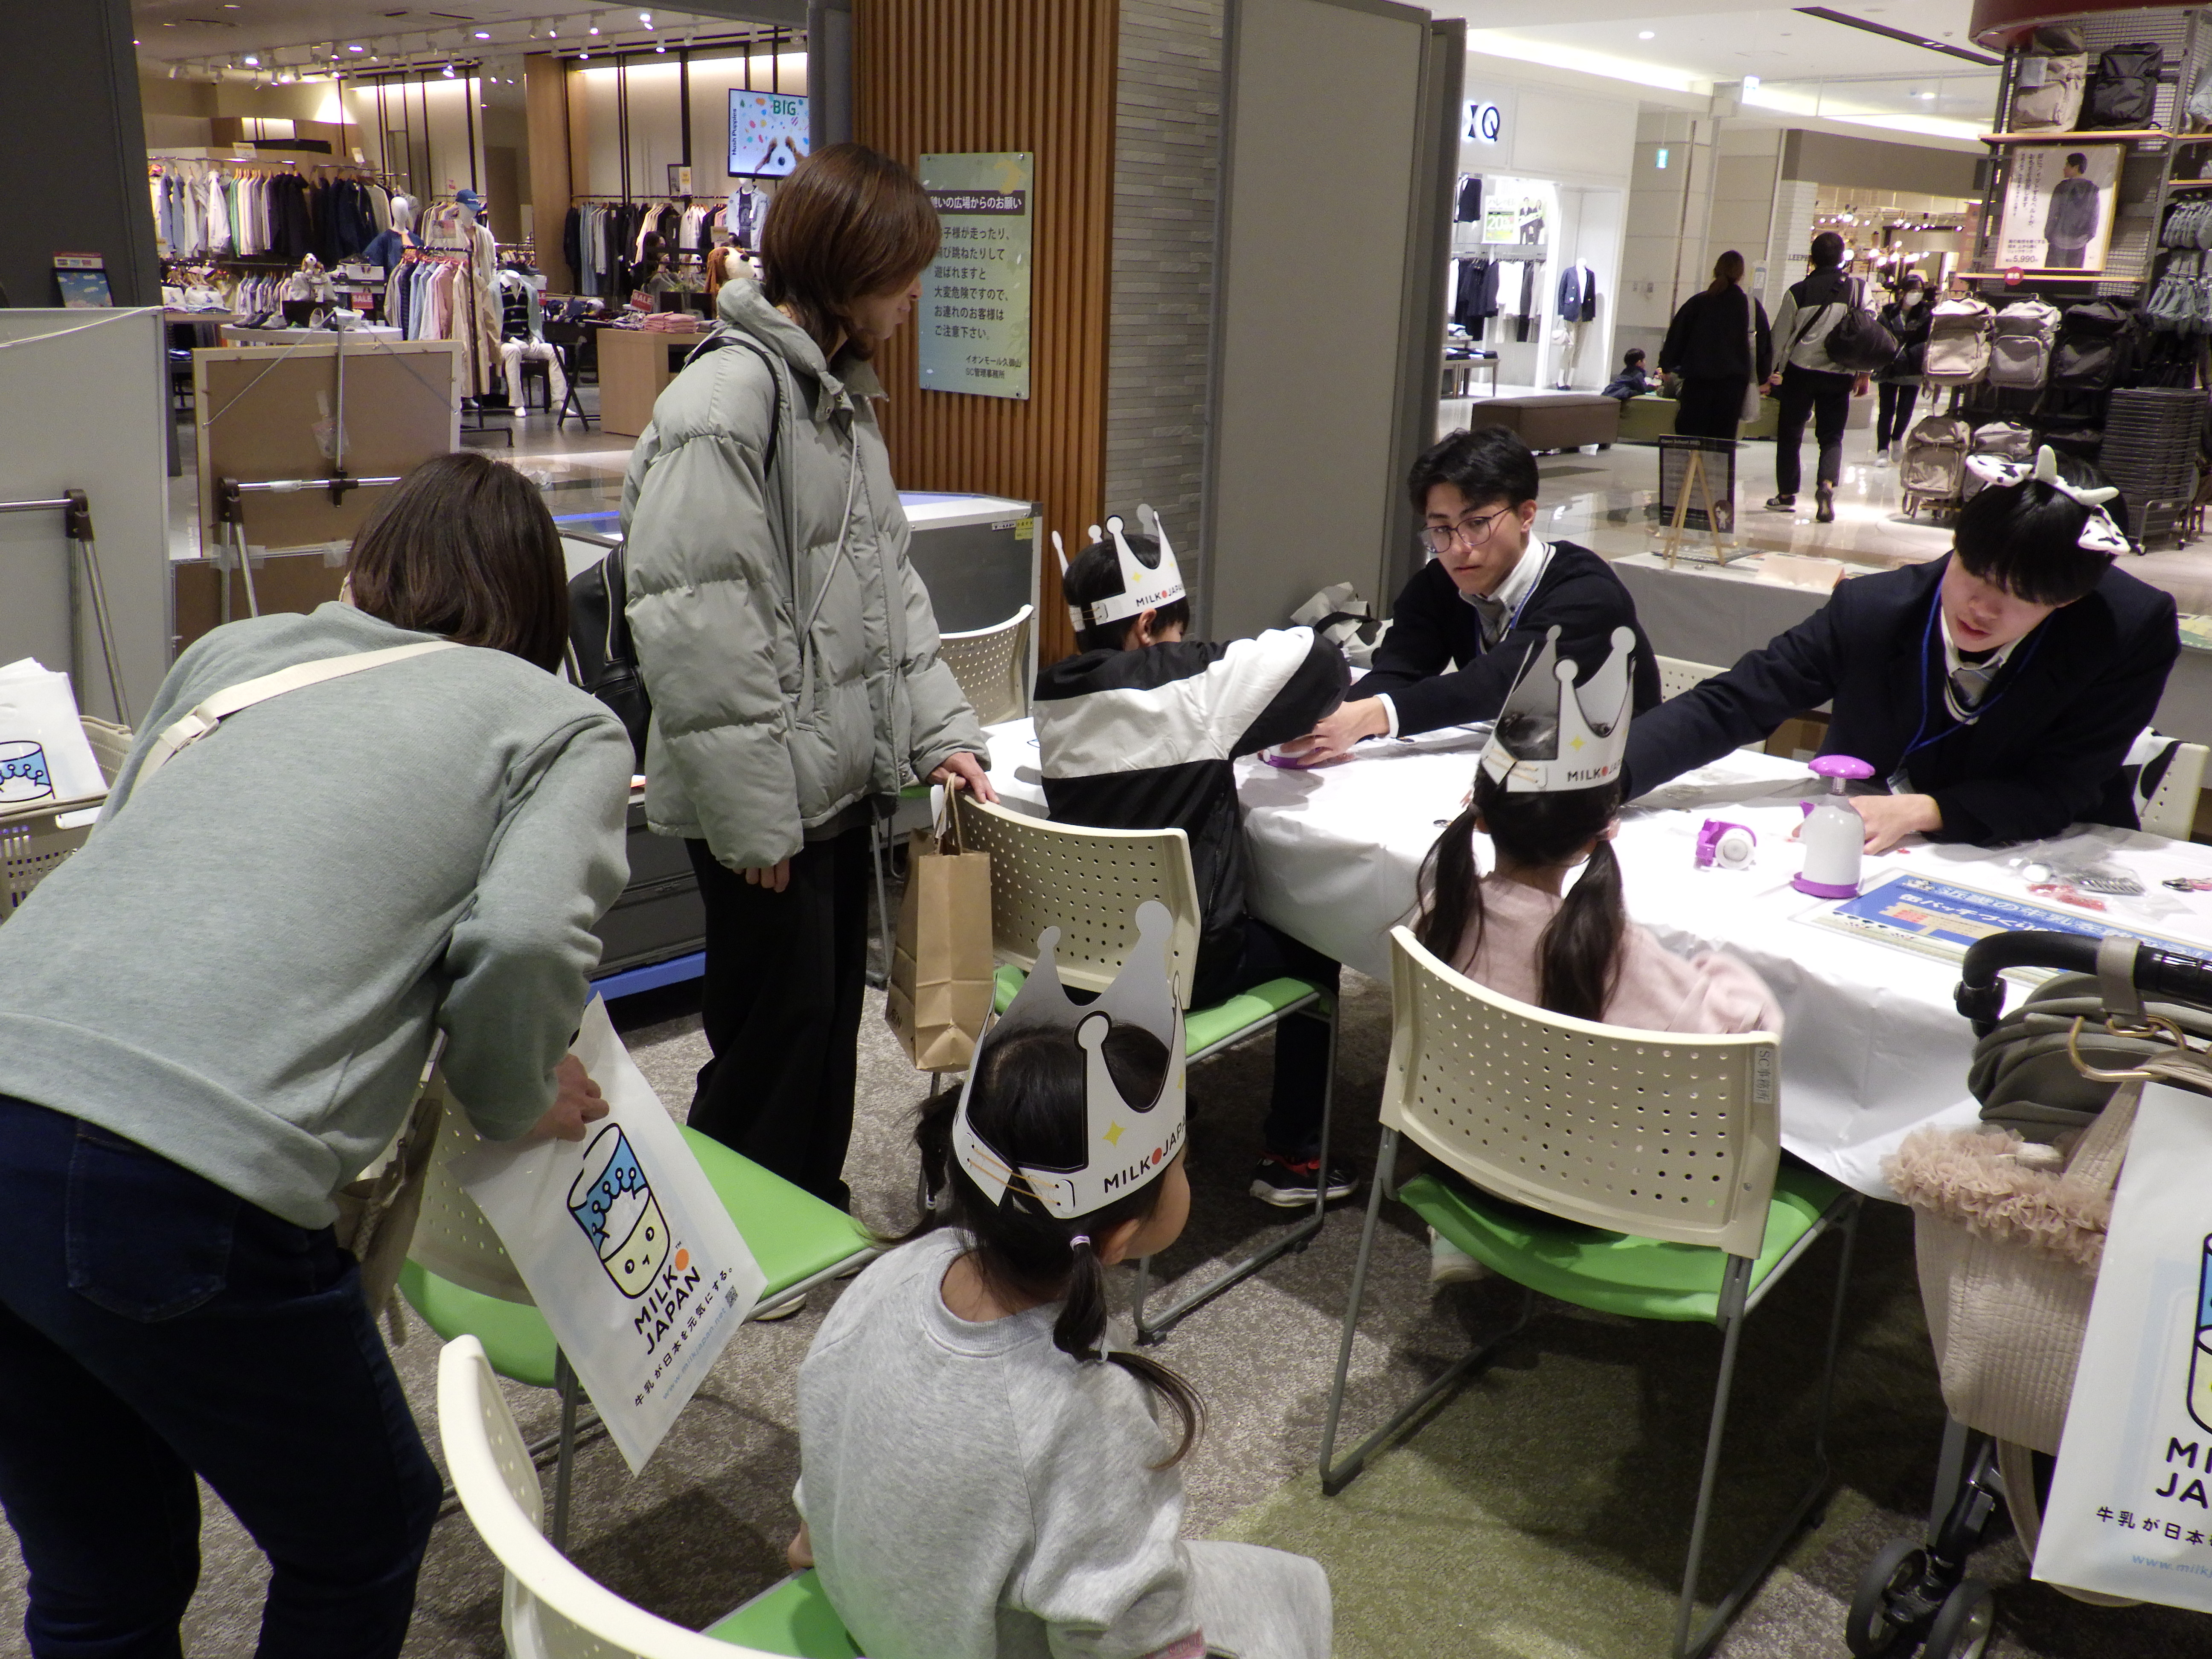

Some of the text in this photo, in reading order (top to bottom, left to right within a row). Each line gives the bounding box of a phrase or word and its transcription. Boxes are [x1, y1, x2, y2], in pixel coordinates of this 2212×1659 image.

[773, 99, 796, 116] BIG
[940, 226, 1009, 240] 子様が走ったり、
[934, 265, 986, 279] 遊ばれますと
[633, 292, 655, 305] SALE
[934, 285, 1008, 301] 大変危険ですので、
[934, 305, 1004, 320] お連れのお客様は
[935, 324, 990, 340] ご注意下さい。
[1136, 593, 1161, 608] MILK
[1567, 768, 1601, 783] MILK
[1103, 1155, 1151, 1194] MILK
[634, 1264, 678, 1335] MILK
[647, 1266, 701, 1355] JAPAN
[635, 1267, 732, 1407] 牛乳が日本を元気にする。
[663, 1307, 726, 1400] www.milkjapan.net
[2156, 1473, 2209, 1510] JA
